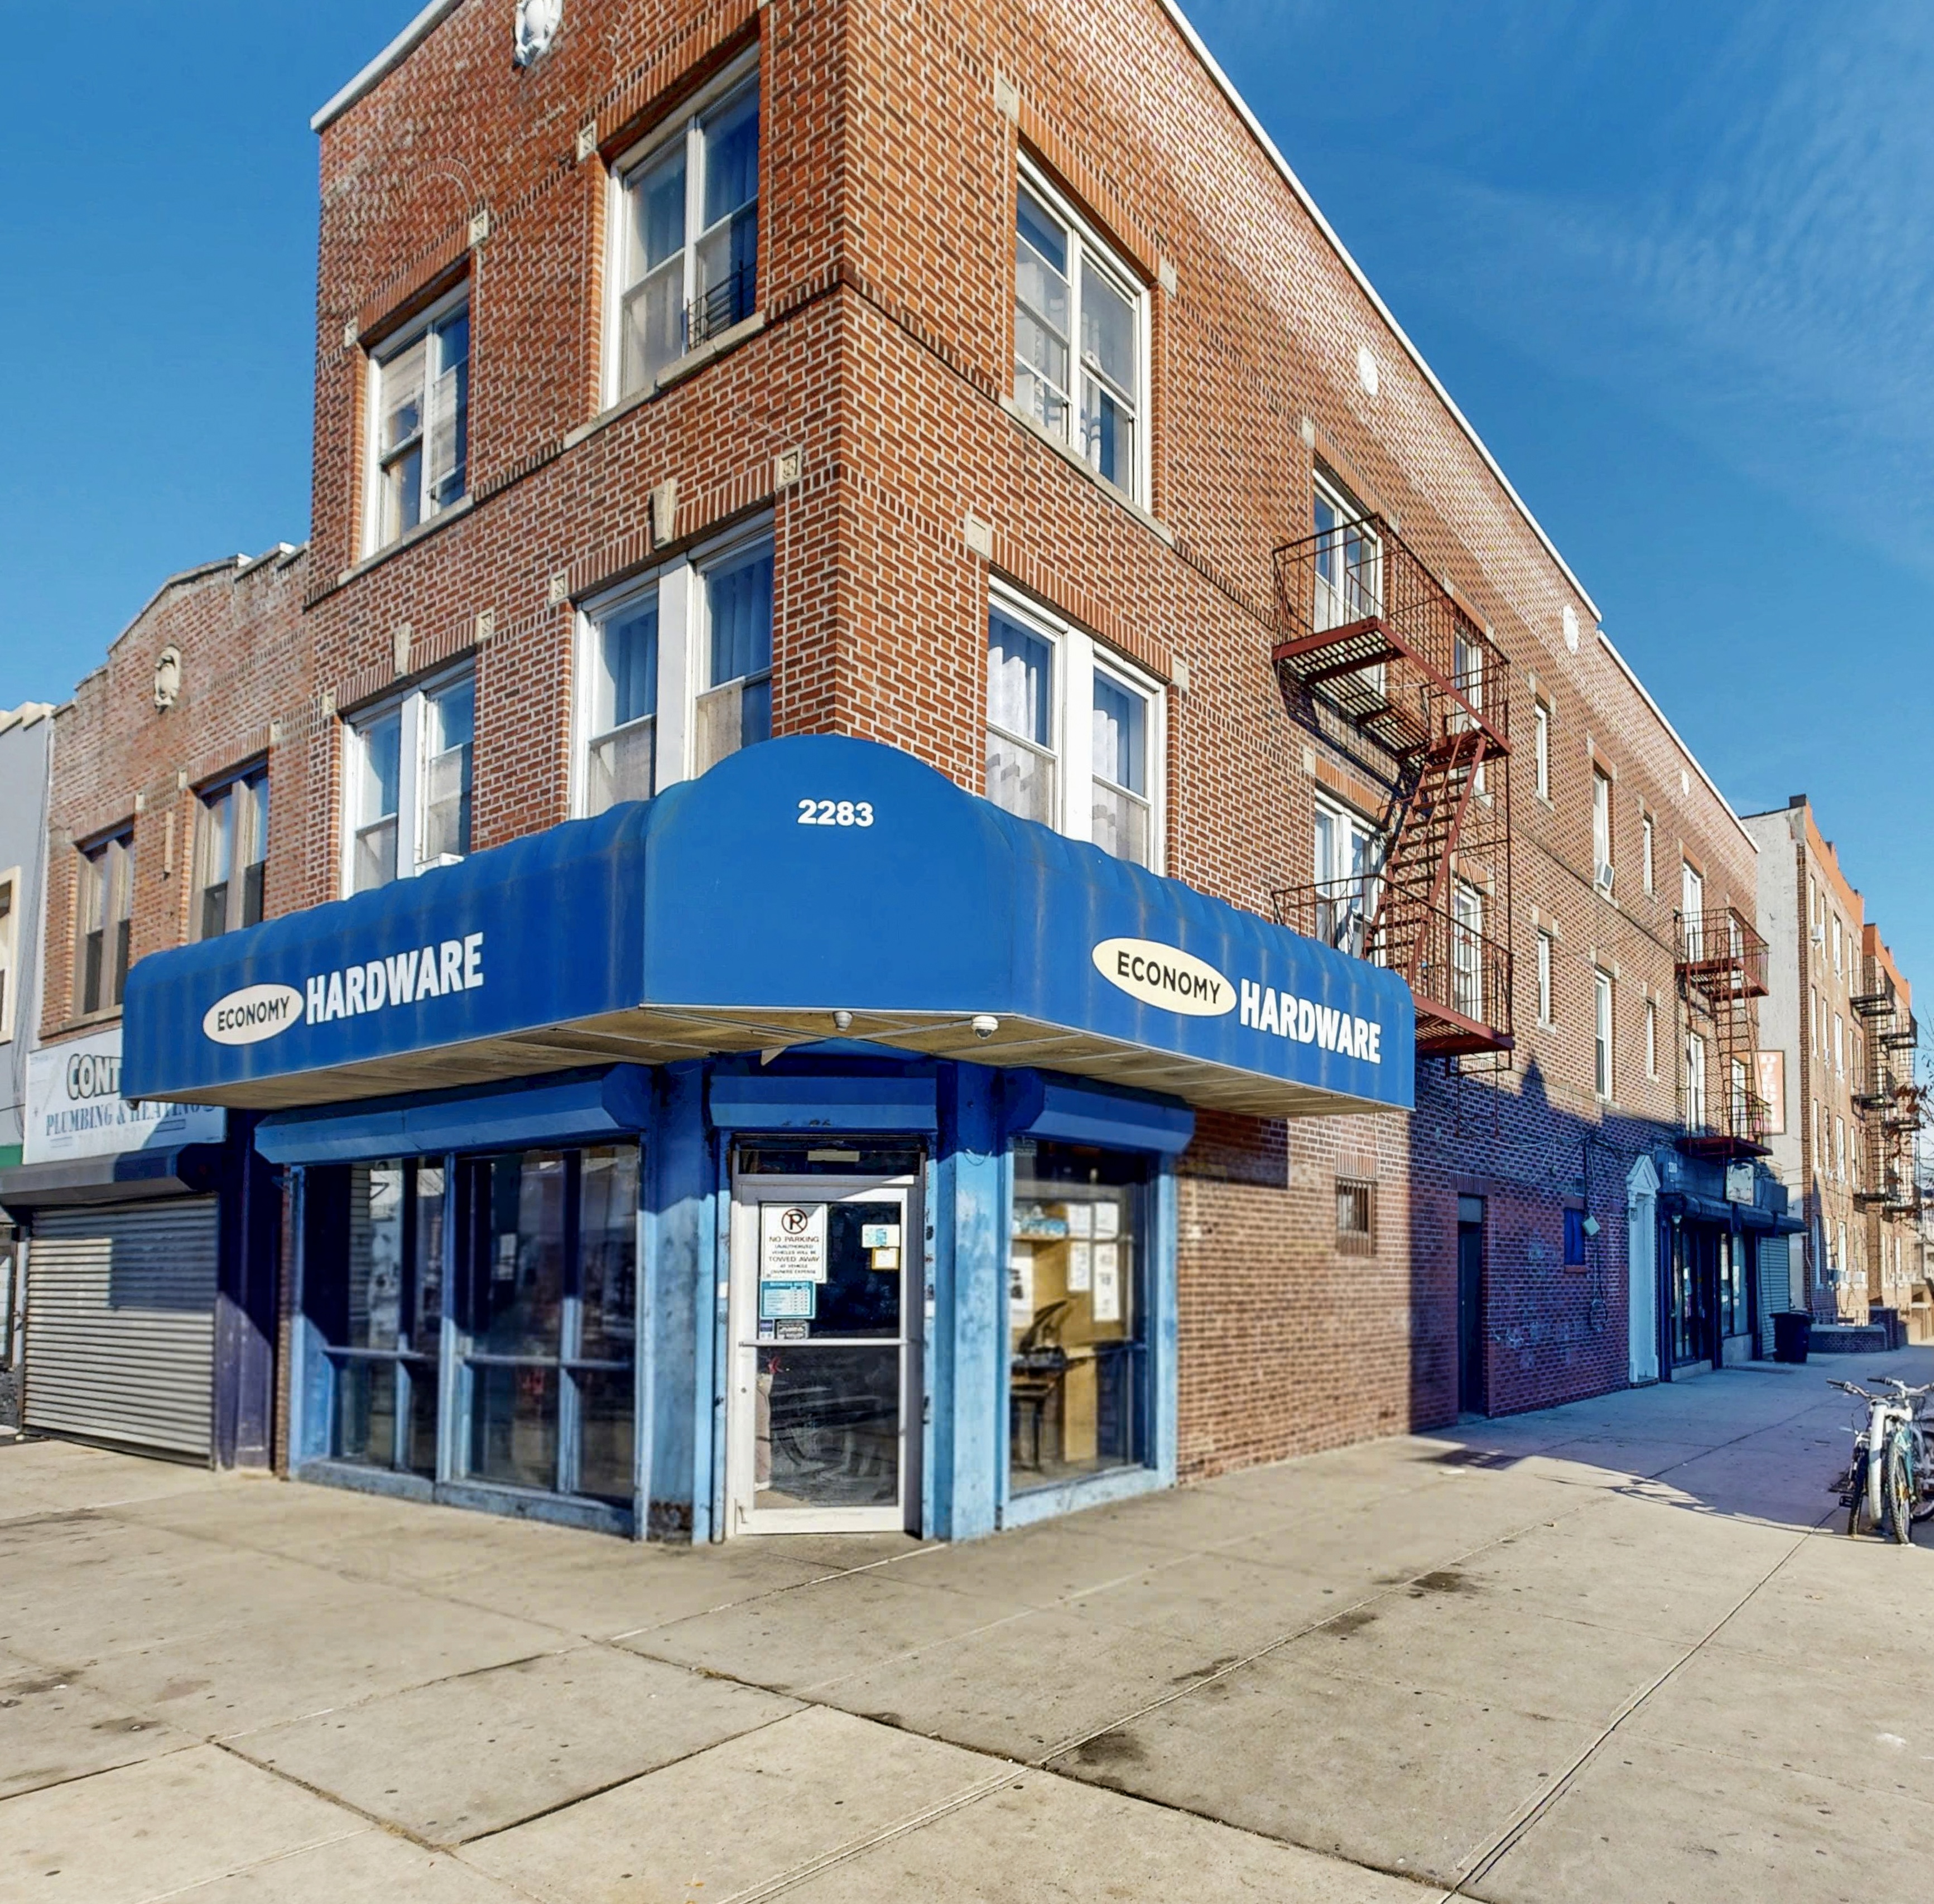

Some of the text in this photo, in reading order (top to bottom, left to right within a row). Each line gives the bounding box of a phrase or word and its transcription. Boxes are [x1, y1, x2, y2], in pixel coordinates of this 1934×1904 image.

[798, 799, 874, 827] 2283
[218, 932, 484, 1031] ECONOMY HARDWARE
[1117, 950, 1381, 1064] ECONOMY HARDWARE
[46, 1103, 112, 1136] PLUMBING
[117, 1102, 126, 1125] &
